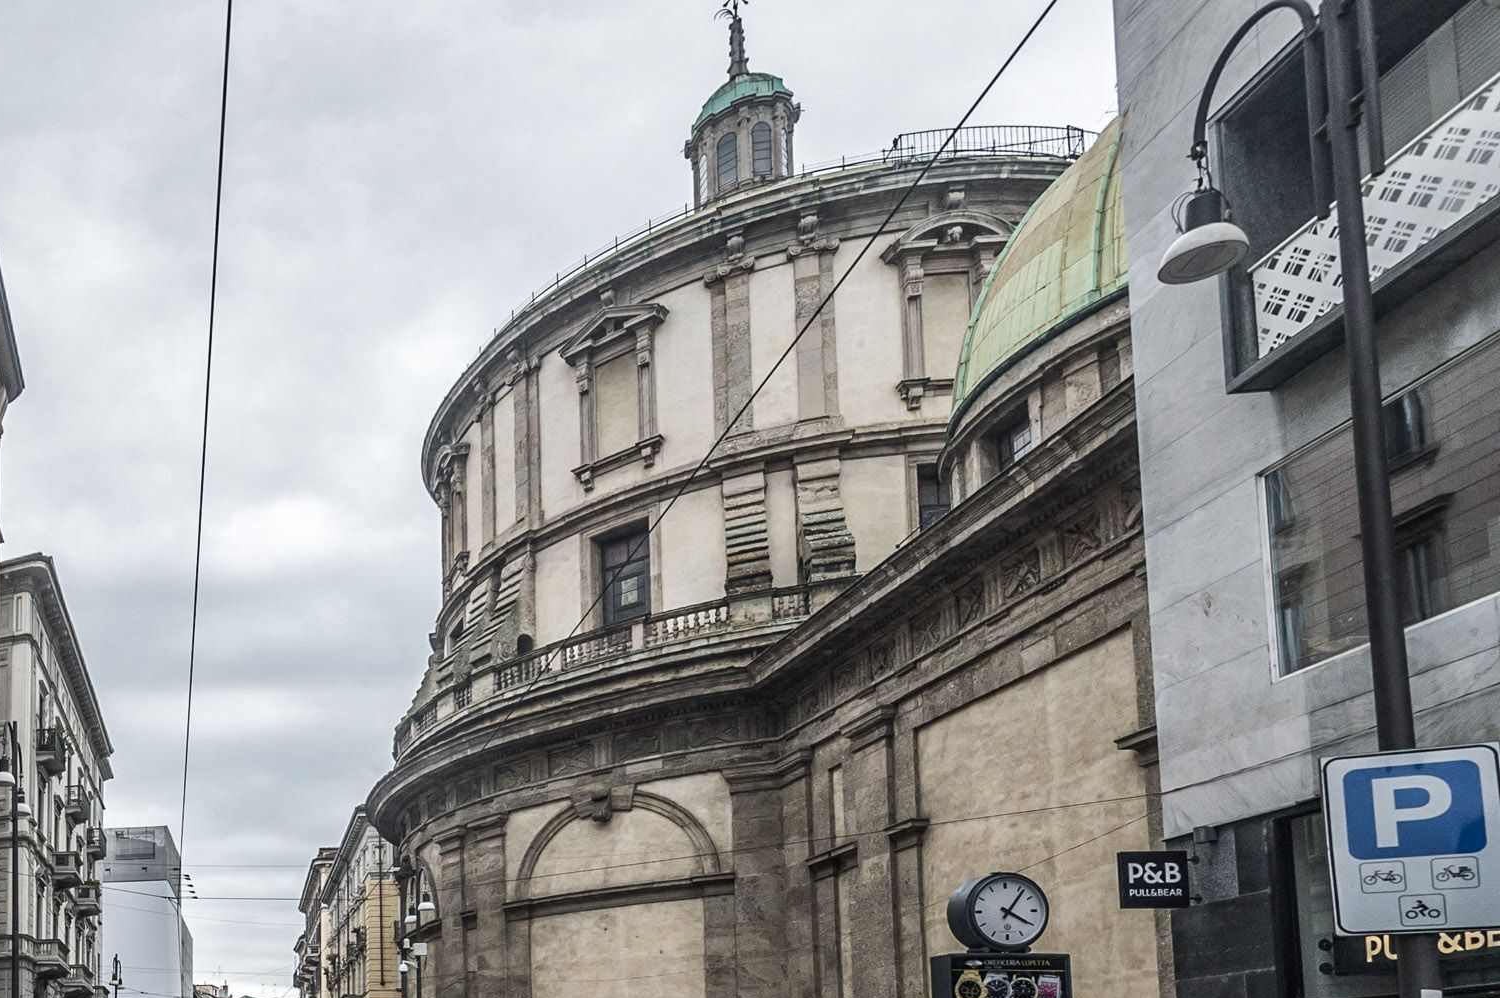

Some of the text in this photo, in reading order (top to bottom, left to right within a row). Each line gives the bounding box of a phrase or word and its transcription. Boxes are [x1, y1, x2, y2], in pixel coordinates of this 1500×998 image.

[1371, 774, 1452, 849] P
[1127, 862, 1182, 884] P&B
[1129, 888, 1182, 897] PULL&BEAR
